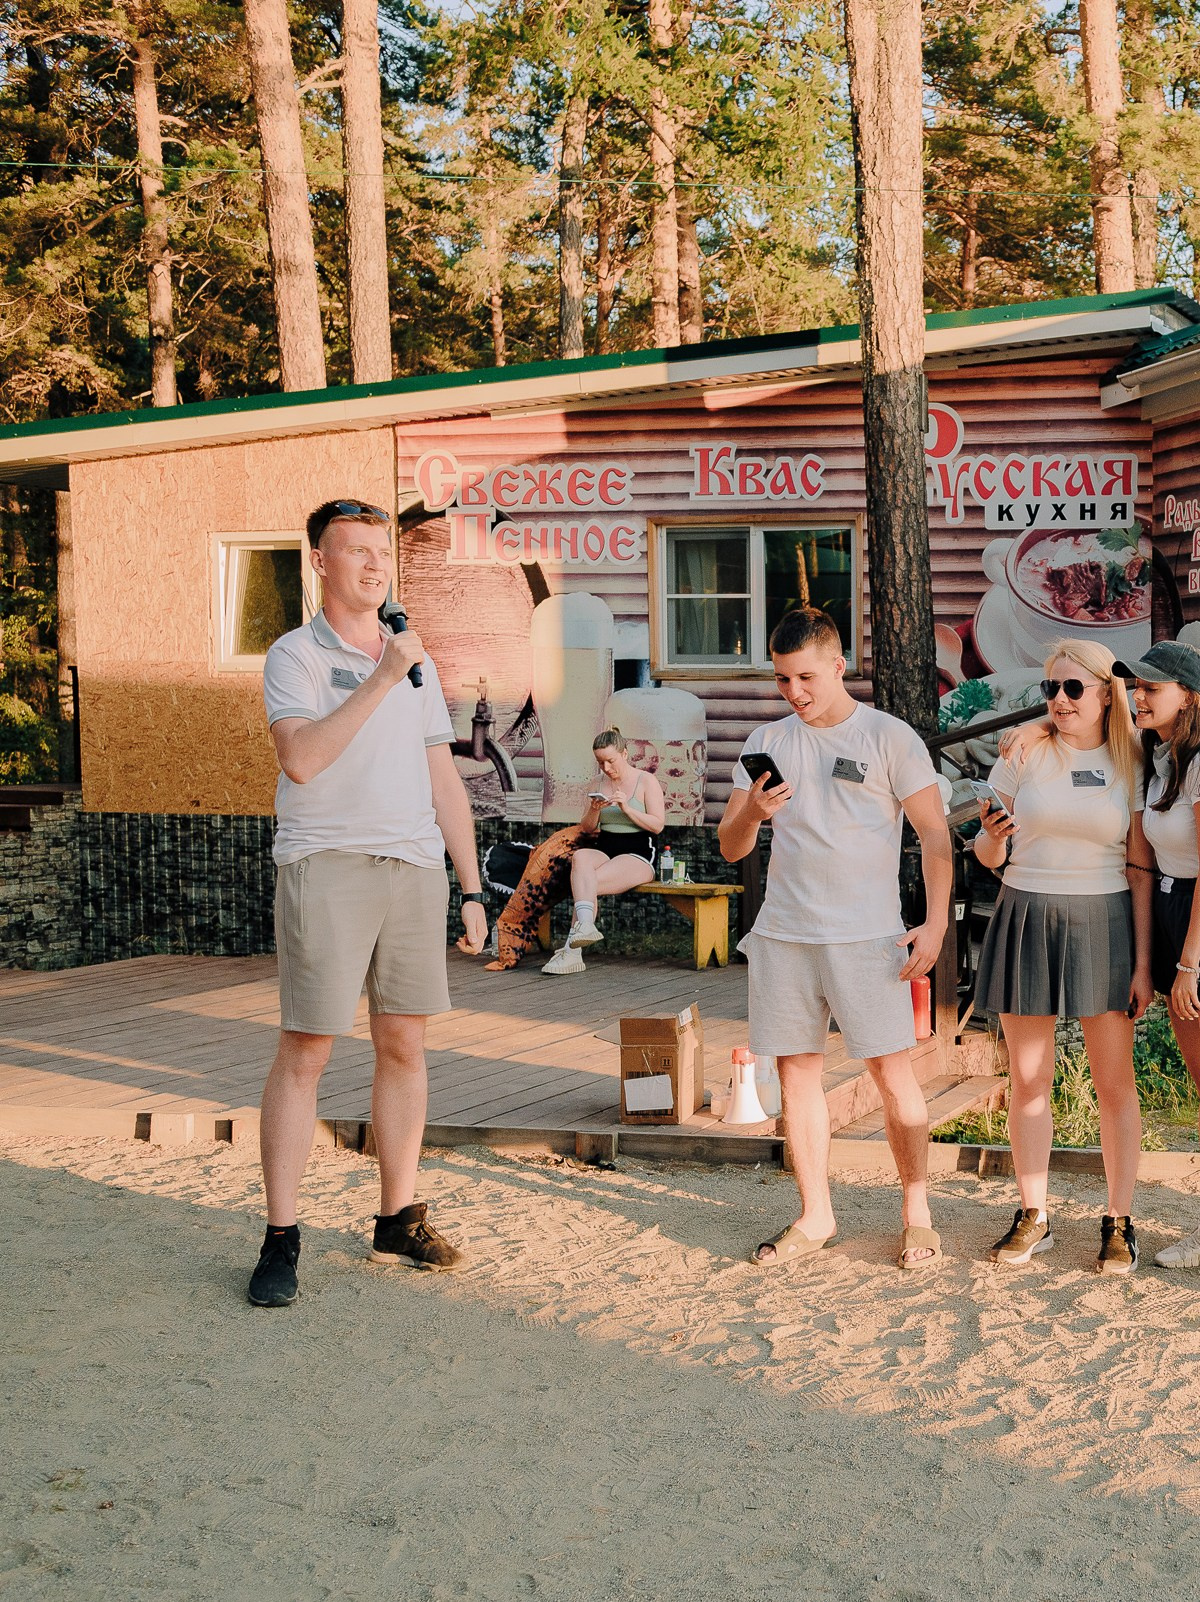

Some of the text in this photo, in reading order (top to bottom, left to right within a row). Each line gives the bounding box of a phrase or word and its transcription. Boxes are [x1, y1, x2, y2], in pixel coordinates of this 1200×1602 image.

[694, 446, 826, 500] Квас
[449, 511, 637, 562] Пенное
[996, 502, 1128, 527] кухня
